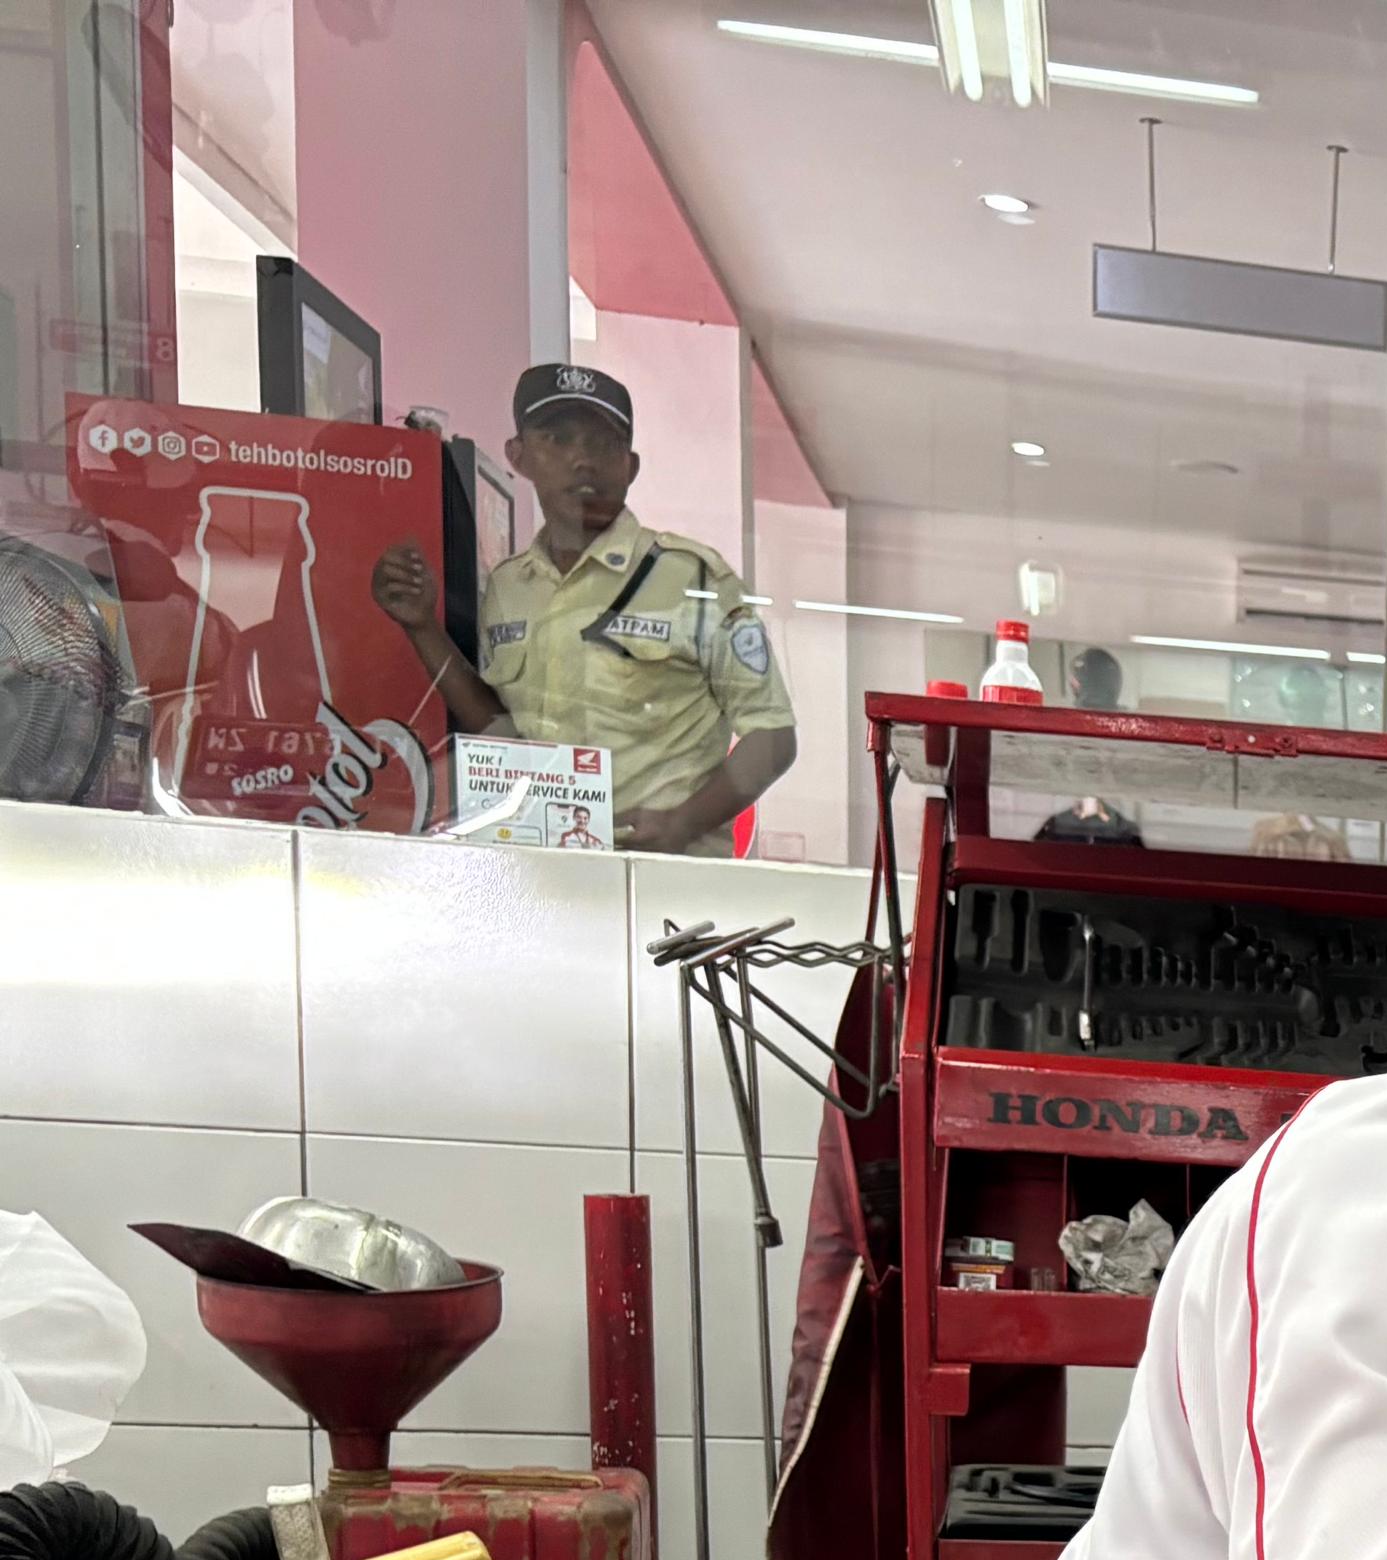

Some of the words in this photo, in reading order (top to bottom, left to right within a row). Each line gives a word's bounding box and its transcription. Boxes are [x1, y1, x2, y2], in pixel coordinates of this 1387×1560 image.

[611, 619, 668, 637] ATPAM
[467, 753, 494, 765] YUK
[231, 764, 294, 797] SOSRO
[468, 766, 500, 778] BERI
[526, 784, 569, 800] ERVICE
[572, 790, 606, 803] KAMI
[987, 1092, 1249, 1141] HONDA
